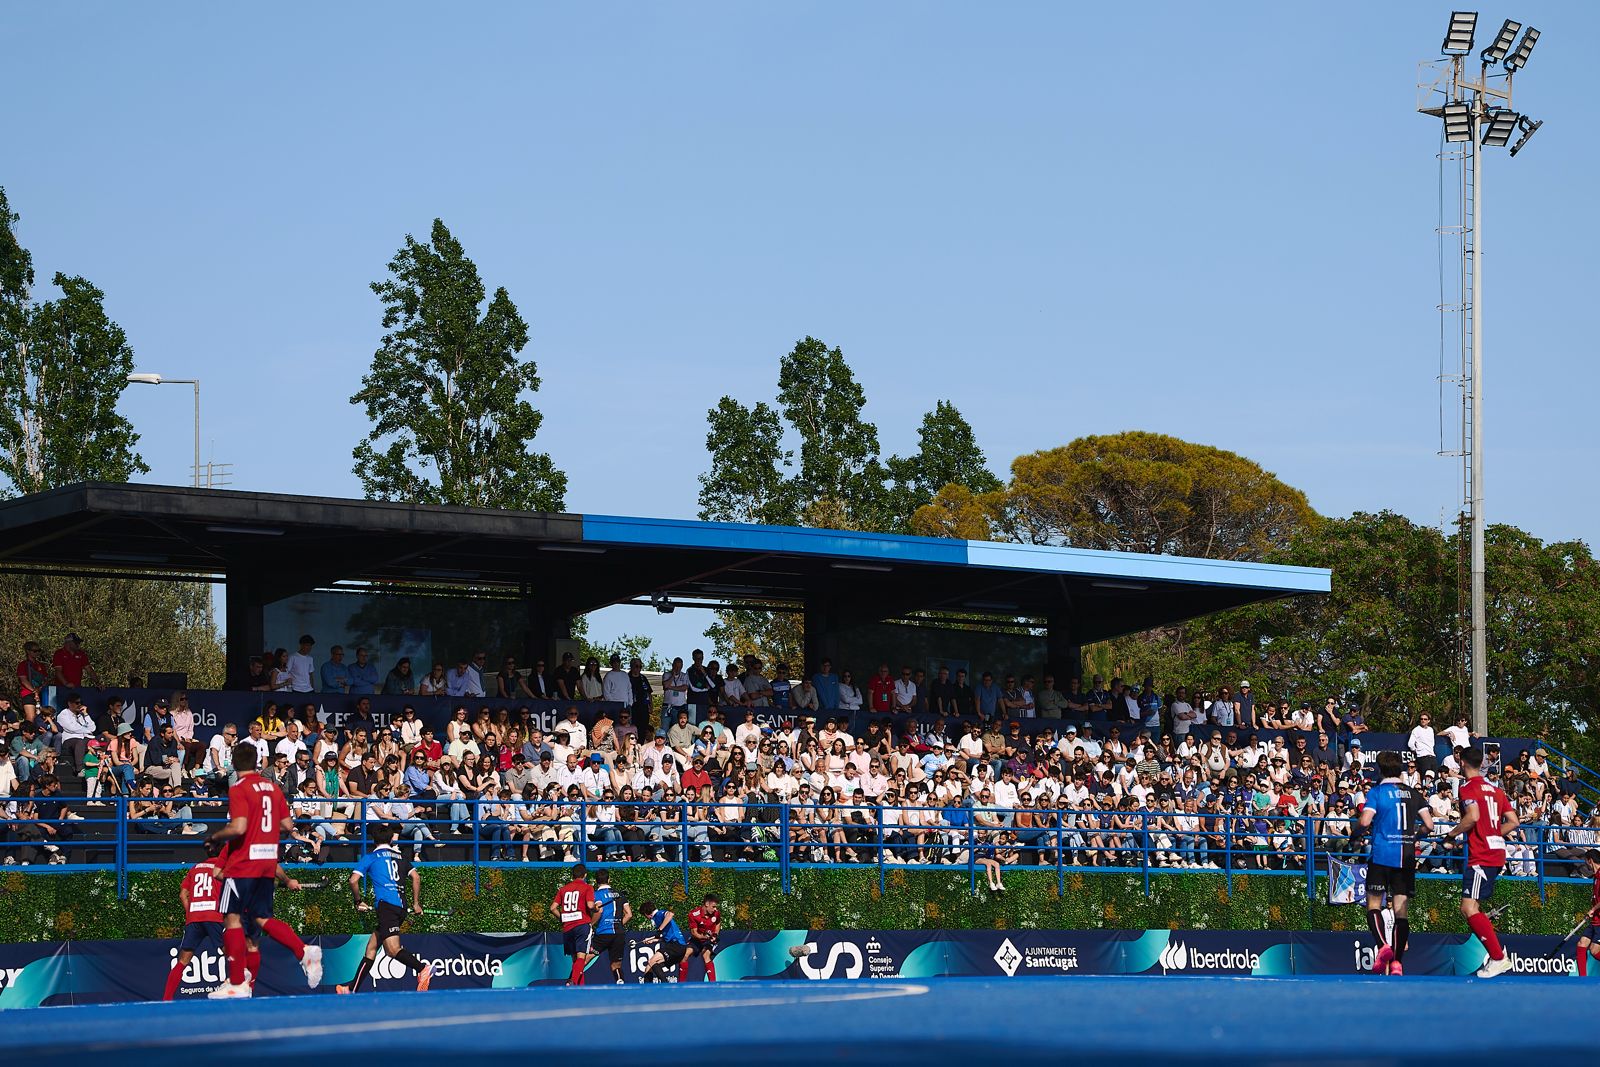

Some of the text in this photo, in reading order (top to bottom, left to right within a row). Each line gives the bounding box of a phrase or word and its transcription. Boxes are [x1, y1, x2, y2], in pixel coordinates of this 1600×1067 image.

[261, 795, 272, 833] 3
[1395, 802, 1407, 831] 11
[1484, 795, 1499, 830] 14
[385, 859, 400, 881] 18
[193, 872, 213, 898] 24
[563, 890, 580, 912] 99
[868, 956, 893, 966] Consejo
[1025, 947, 1077, 956] AJUNTAMENT DE
[1189, 947, 1260, 969] Iberdrola
[1510, 952, 1577, 973] Iberdrola
[870, 964, 895, 973] Superior
[1026, 956, 1078, 970] SantCugat
[181, 987, 205, 995] Seguros
